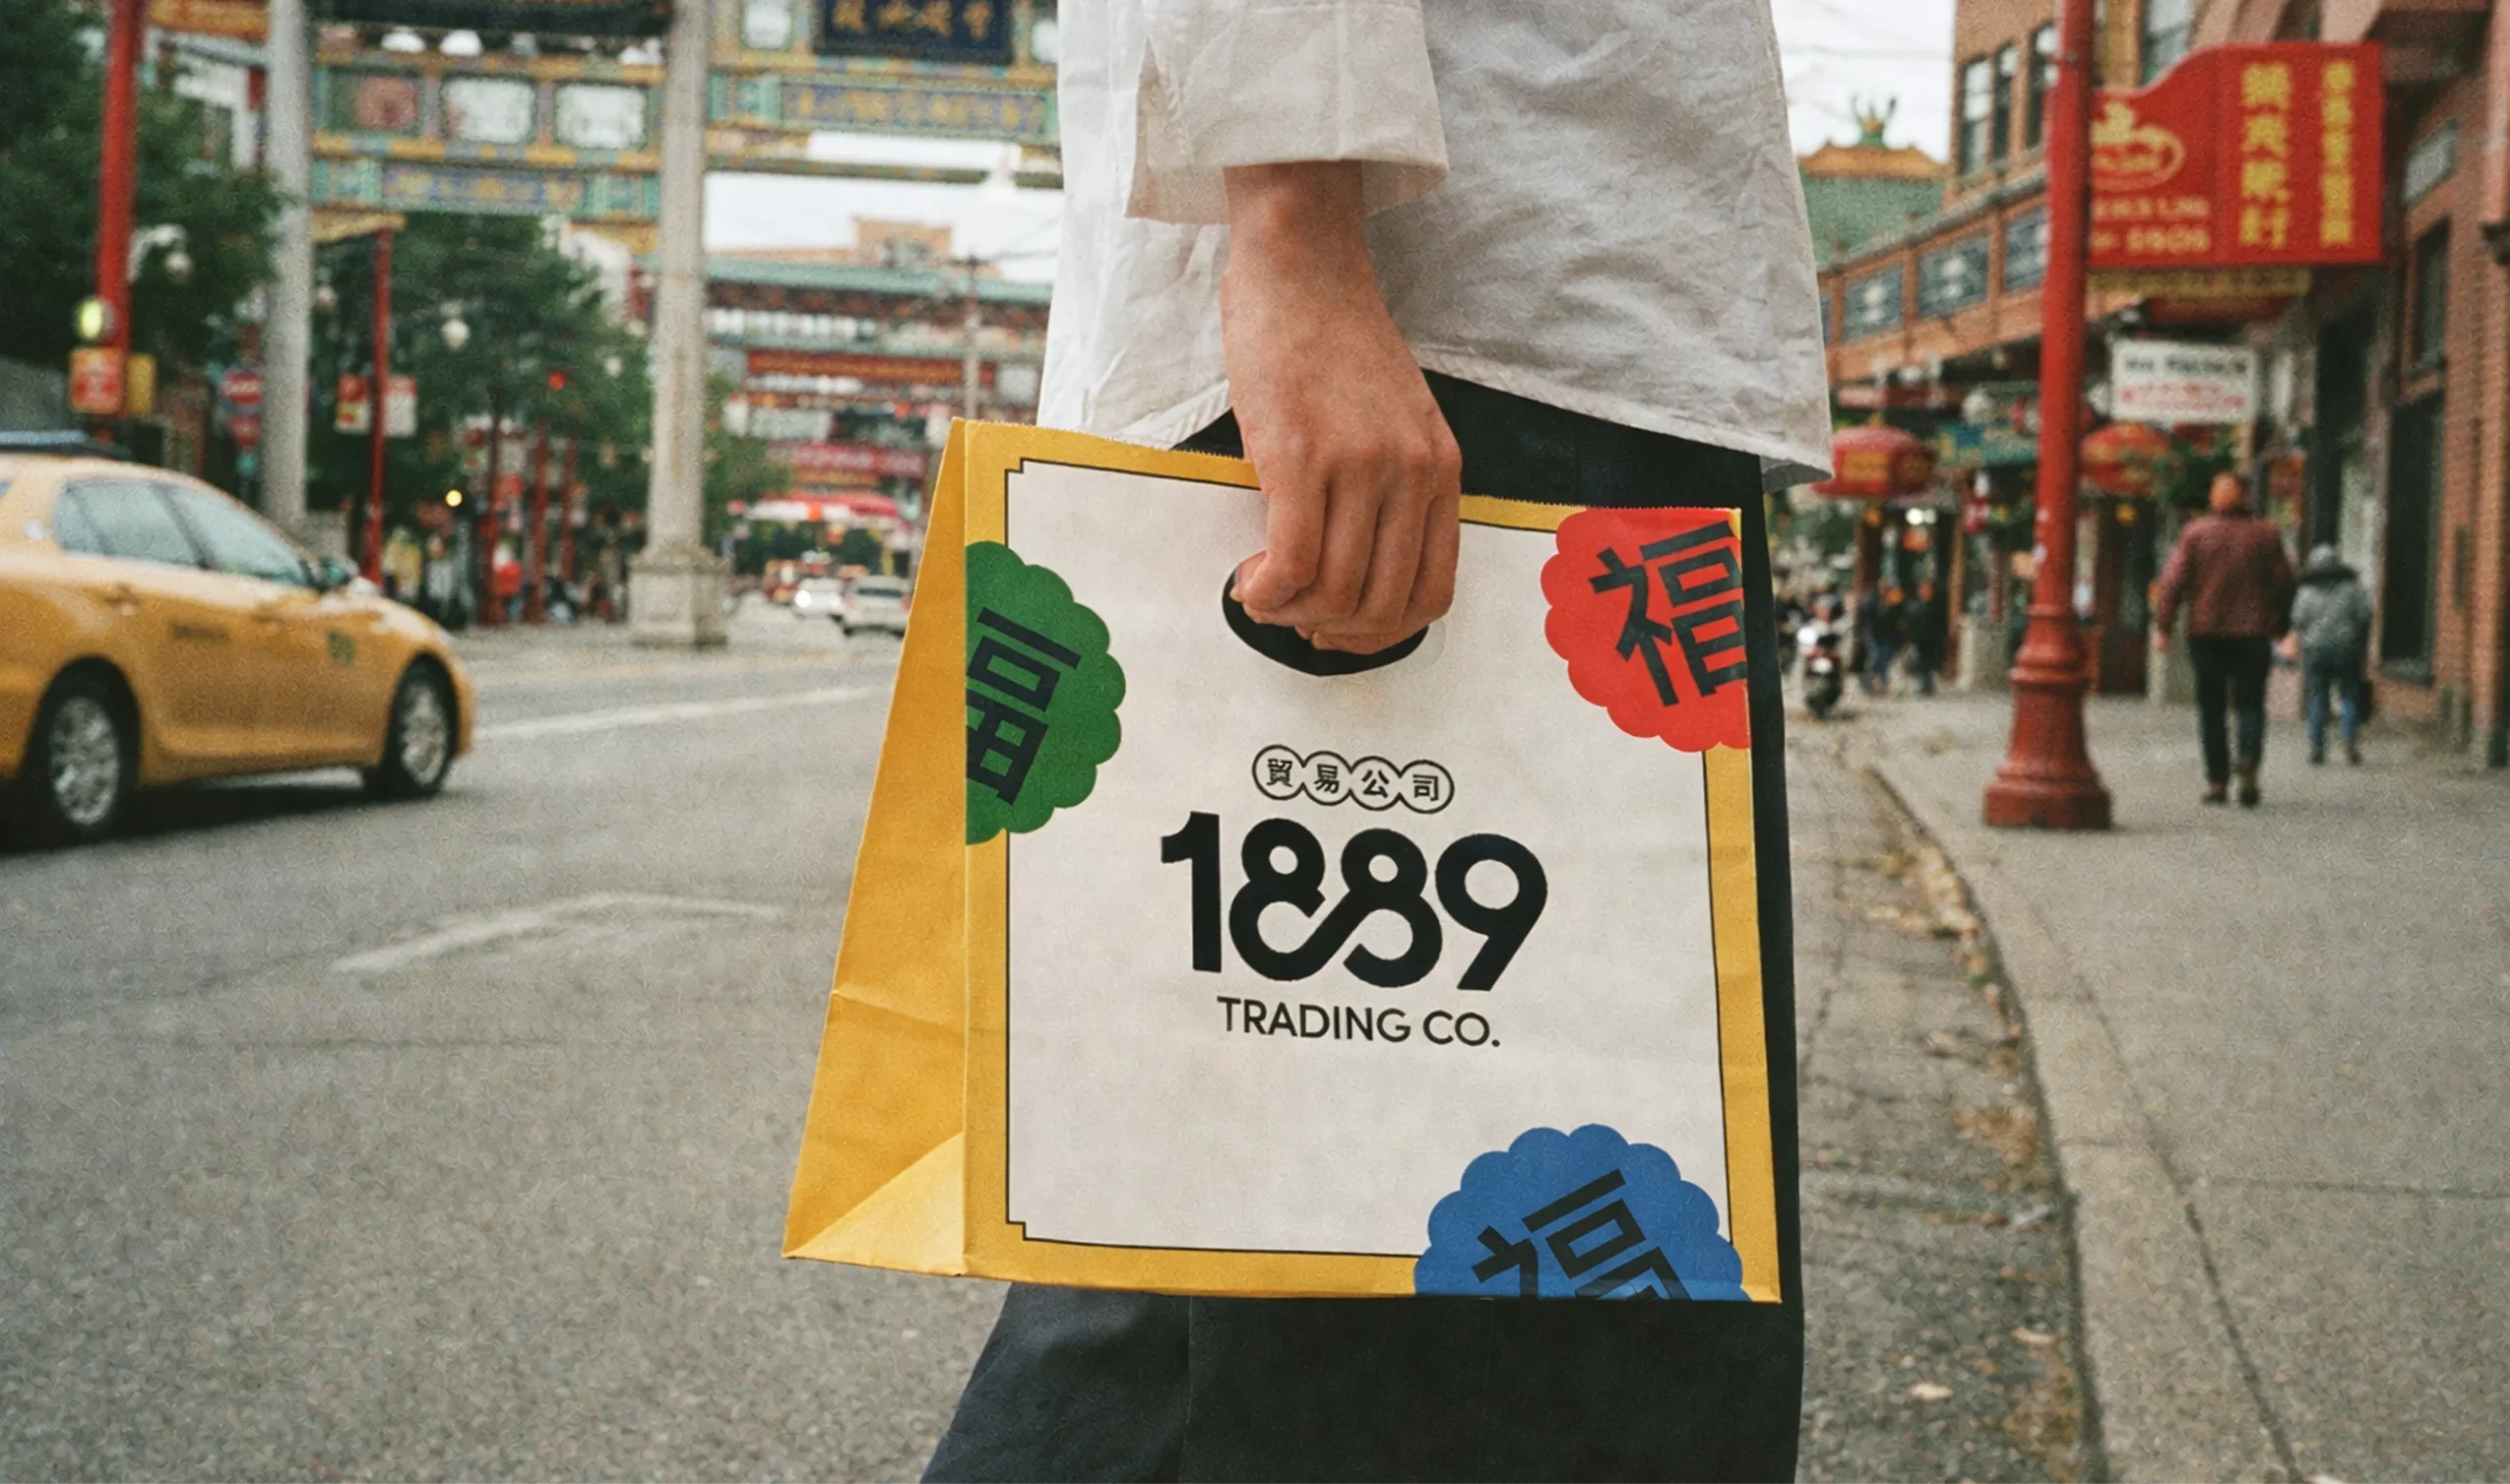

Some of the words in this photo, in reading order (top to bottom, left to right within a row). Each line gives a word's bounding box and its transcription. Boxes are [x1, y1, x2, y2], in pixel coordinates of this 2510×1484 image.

[1266, 758, 1440, 802] 貿易公司
[1161, 810, 1548, 992] 1889
[1217, 995, 1411, 1043] TRADING
[1423, 1009, 1500, 1048] CO.
